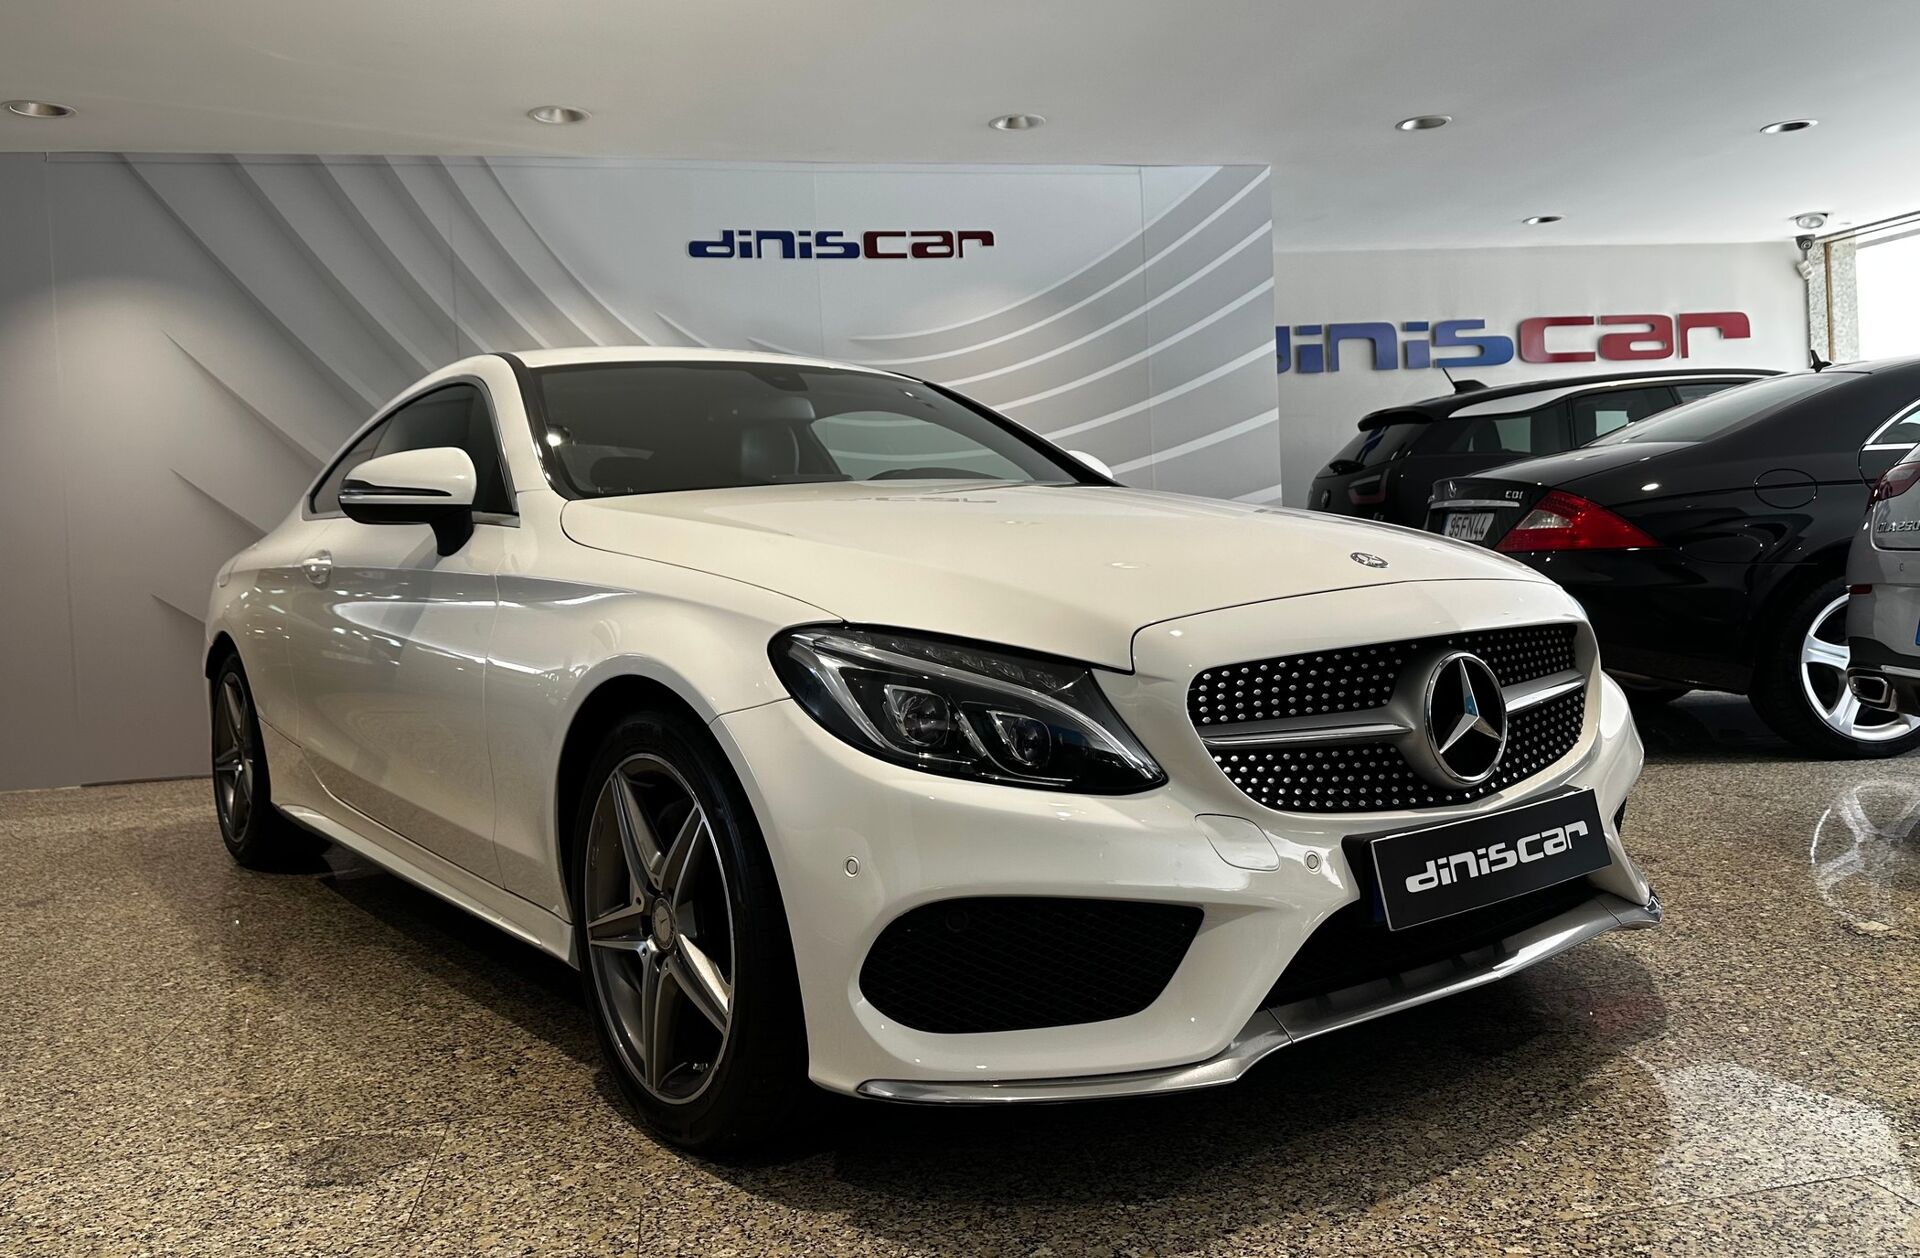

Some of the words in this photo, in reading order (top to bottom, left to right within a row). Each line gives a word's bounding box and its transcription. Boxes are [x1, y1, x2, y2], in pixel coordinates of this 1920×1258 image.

[688, 230, 995, 259] diniscar
[1275, 311, 1751, 374] iniscar
[1405, 820, 1589, 893] diniscar
